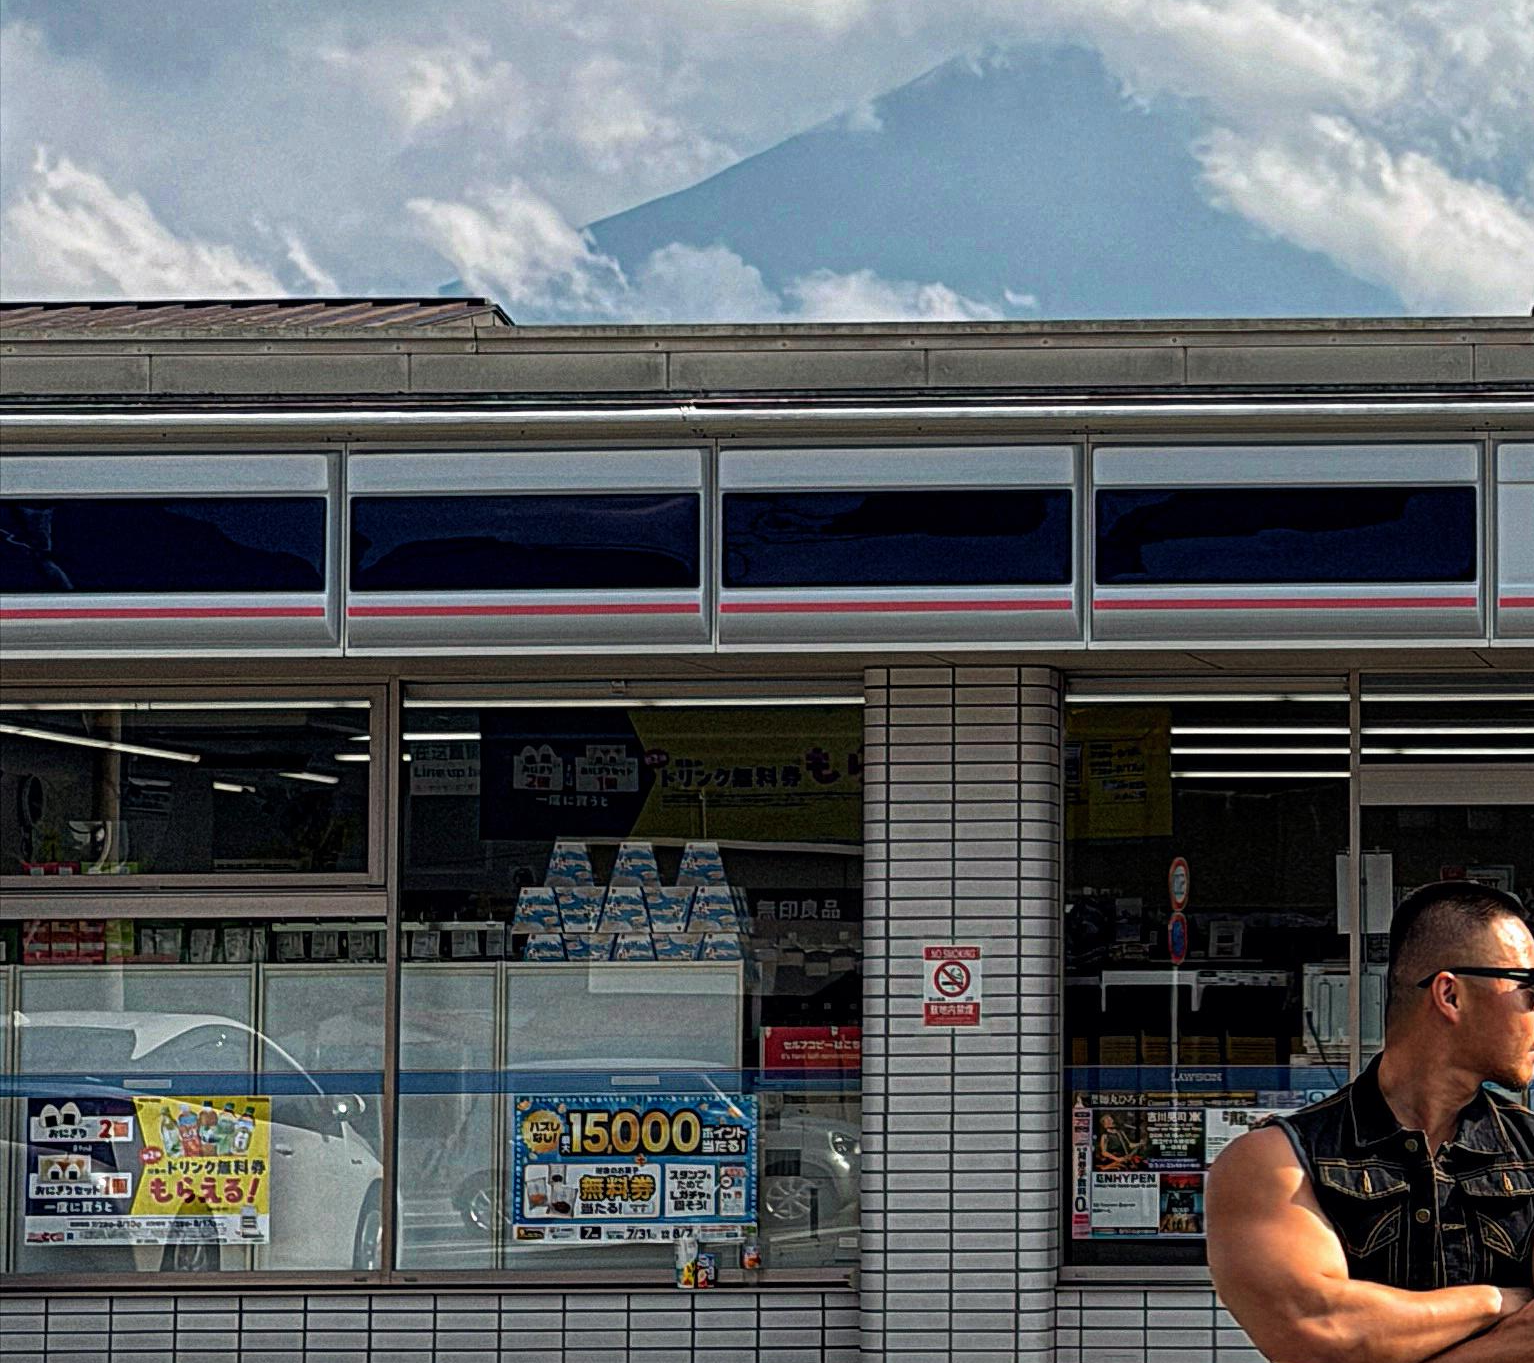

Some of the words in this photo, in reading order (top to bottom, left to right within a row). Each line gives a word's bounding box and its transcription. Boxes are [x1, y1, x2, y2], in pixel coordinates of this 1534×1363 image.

[756, 899, 841, 920] 無印良品
[569, 1111, 701, 1155] 15,000
[702, 1126, 747, 1139] ポイント
[580, 1175, 655, 1201] 無料券
[1096, 1173, 1156, 1184] ENHYPEN
[150, 1177, 260, 1204] もらえる!
